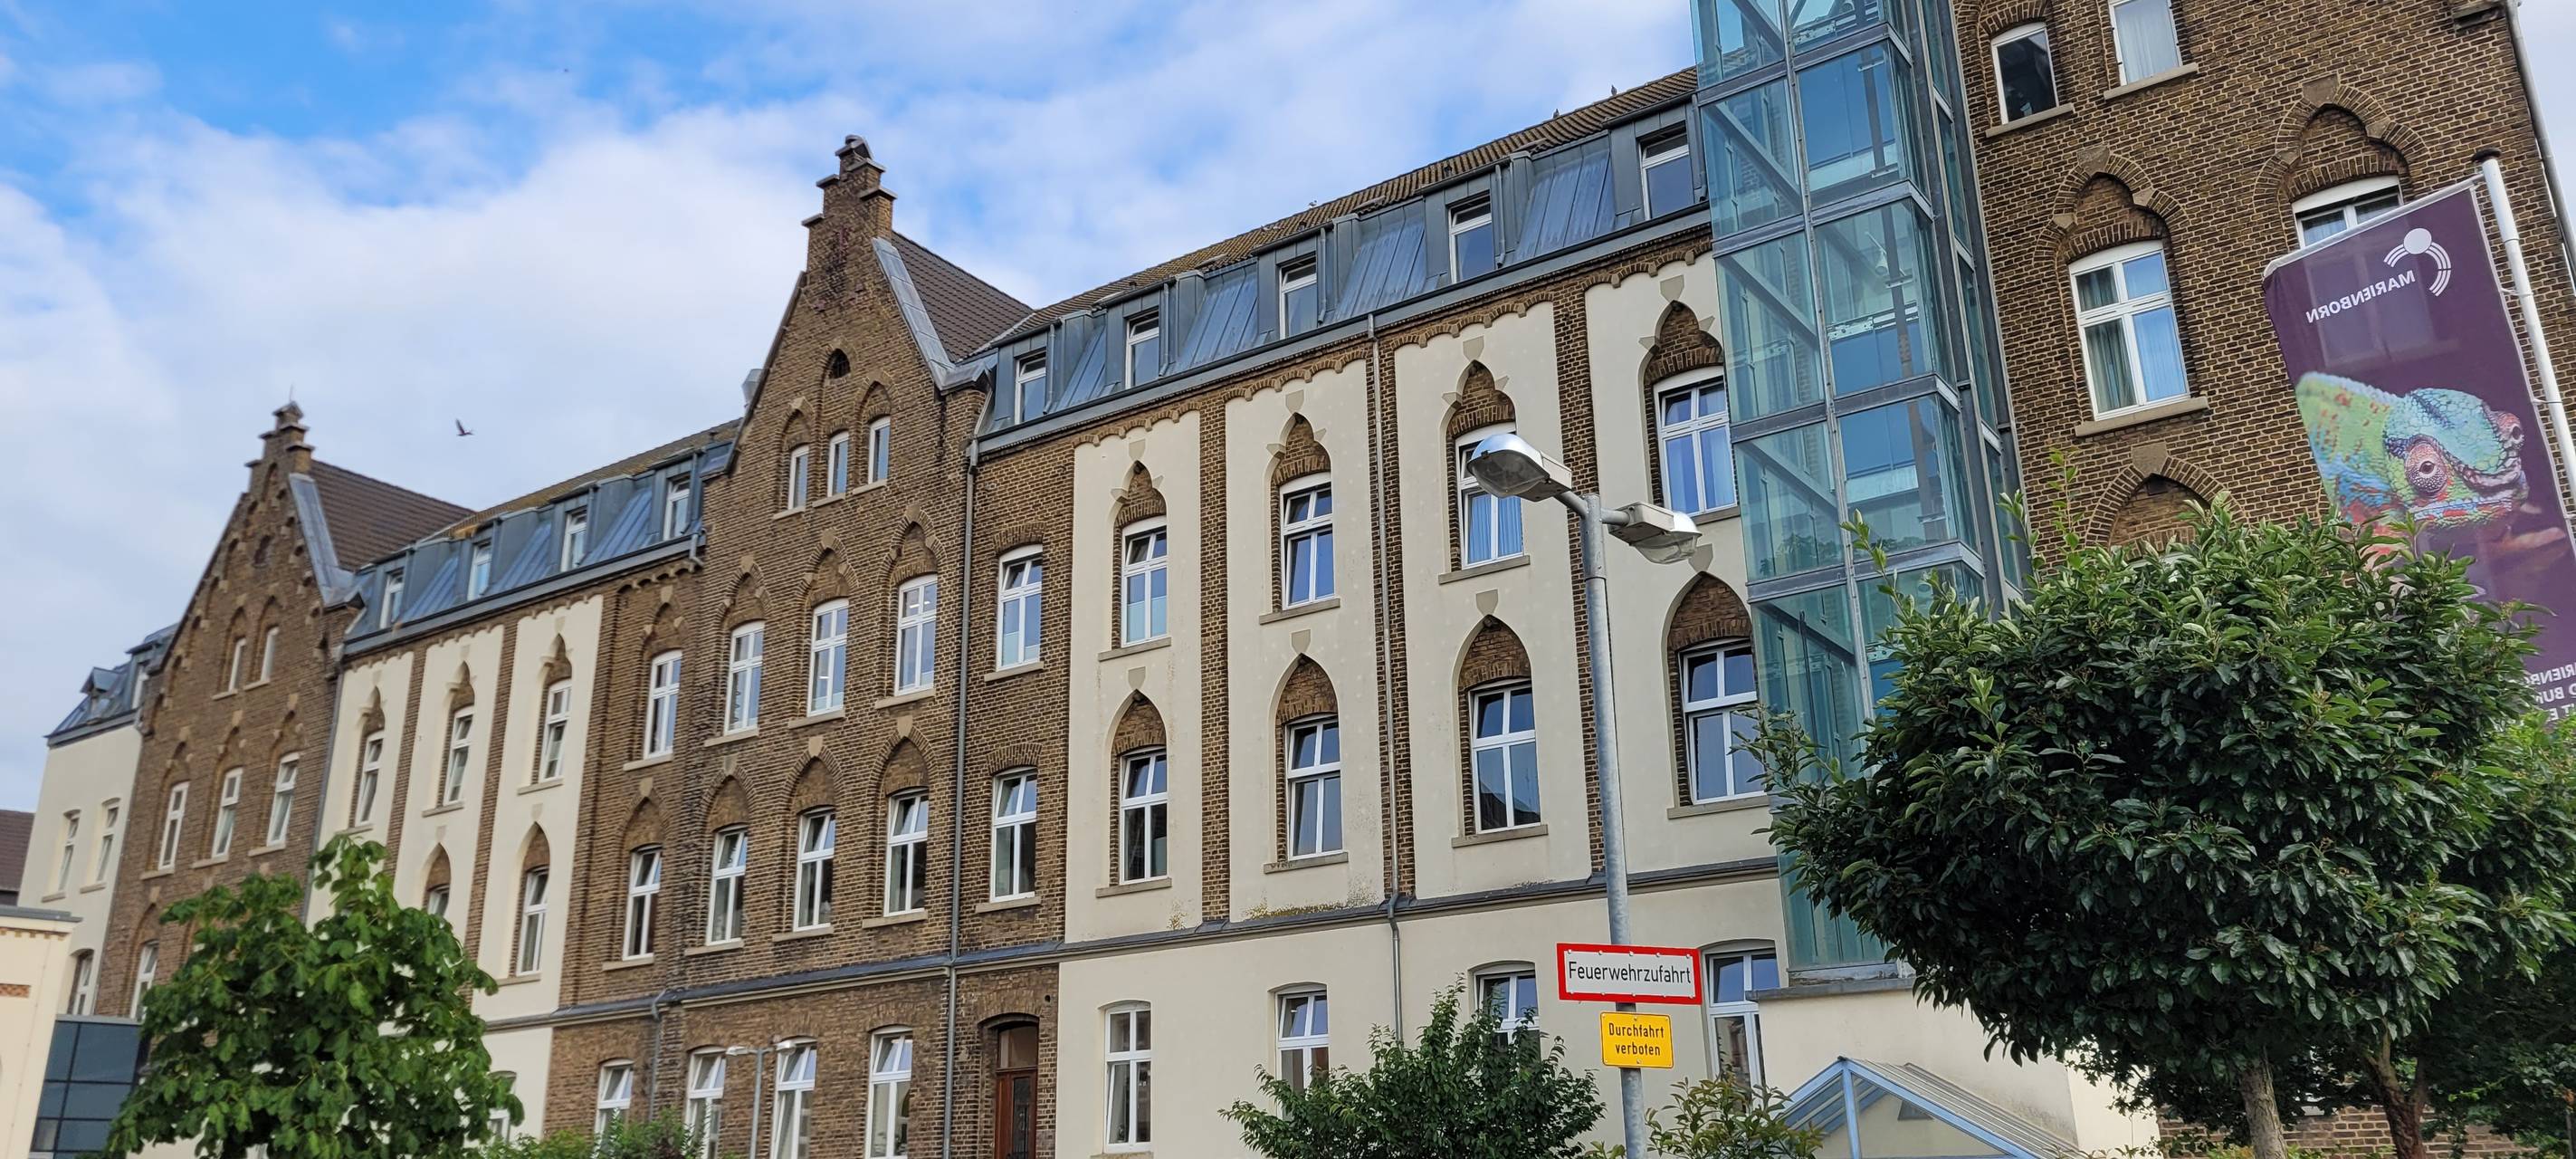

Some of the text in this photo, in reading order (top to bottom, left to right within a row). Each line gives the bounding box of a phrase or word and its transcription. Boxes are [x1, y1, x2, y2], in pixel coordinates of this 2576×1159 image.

[1569, 962, 1692, 984] Feuerwehrzufahrt
[1608, 1022, 1665, 1039] Durchfahrt
[1615, 1042, 1661, 1057] verboten
